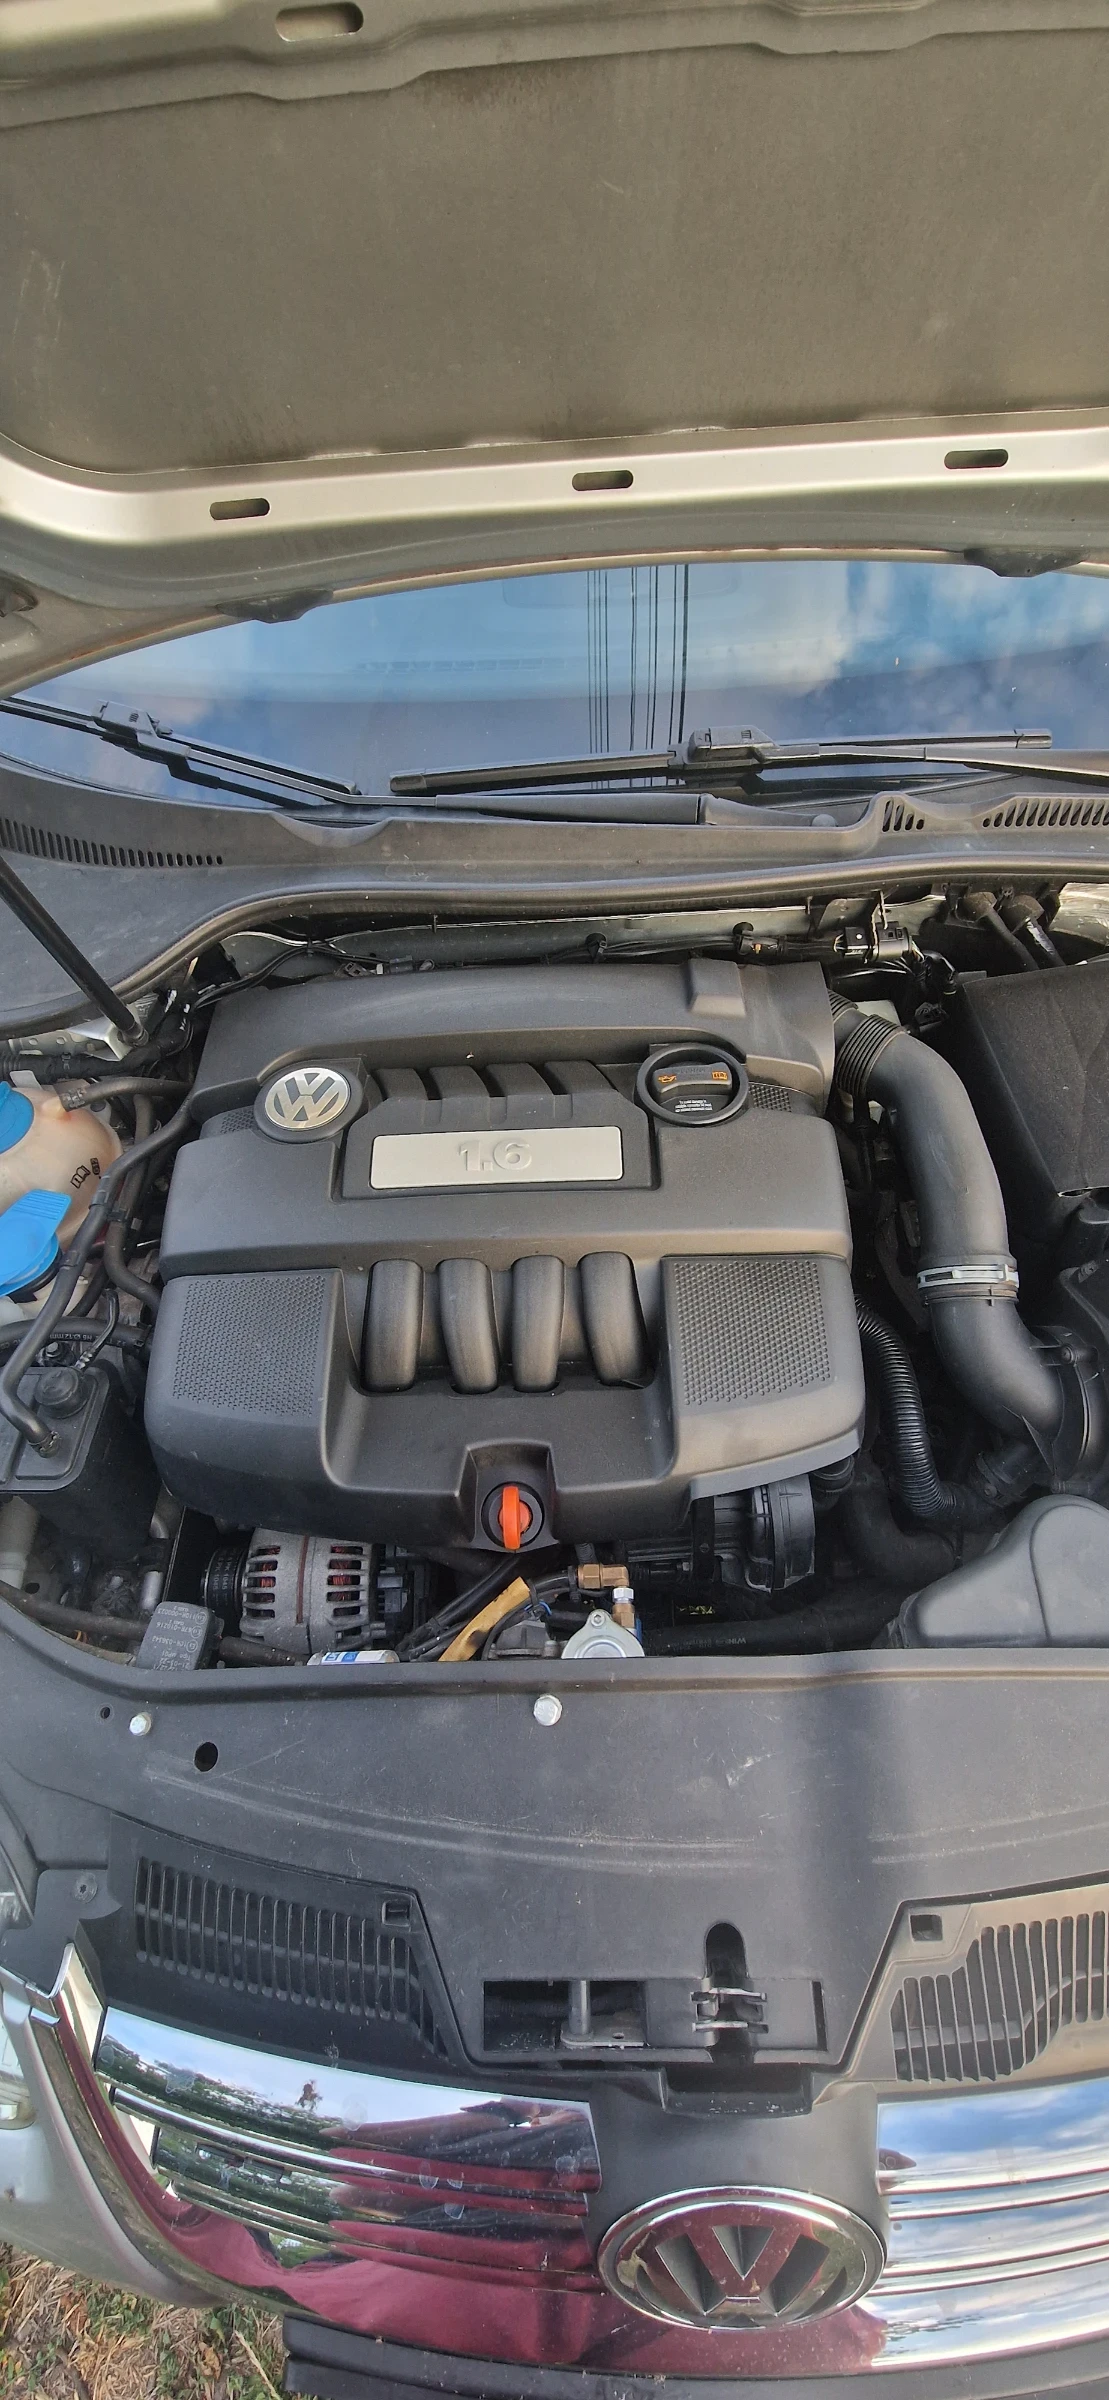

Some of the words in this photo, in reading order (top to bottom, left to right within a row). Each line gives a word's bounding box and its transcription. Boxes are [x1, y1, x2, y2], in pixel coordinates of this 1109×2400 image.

[265, 1067, 350, 1129] VW
[459, 1138, 533, 1173] 1.6
[607, 2190, 880, 2331] VW
